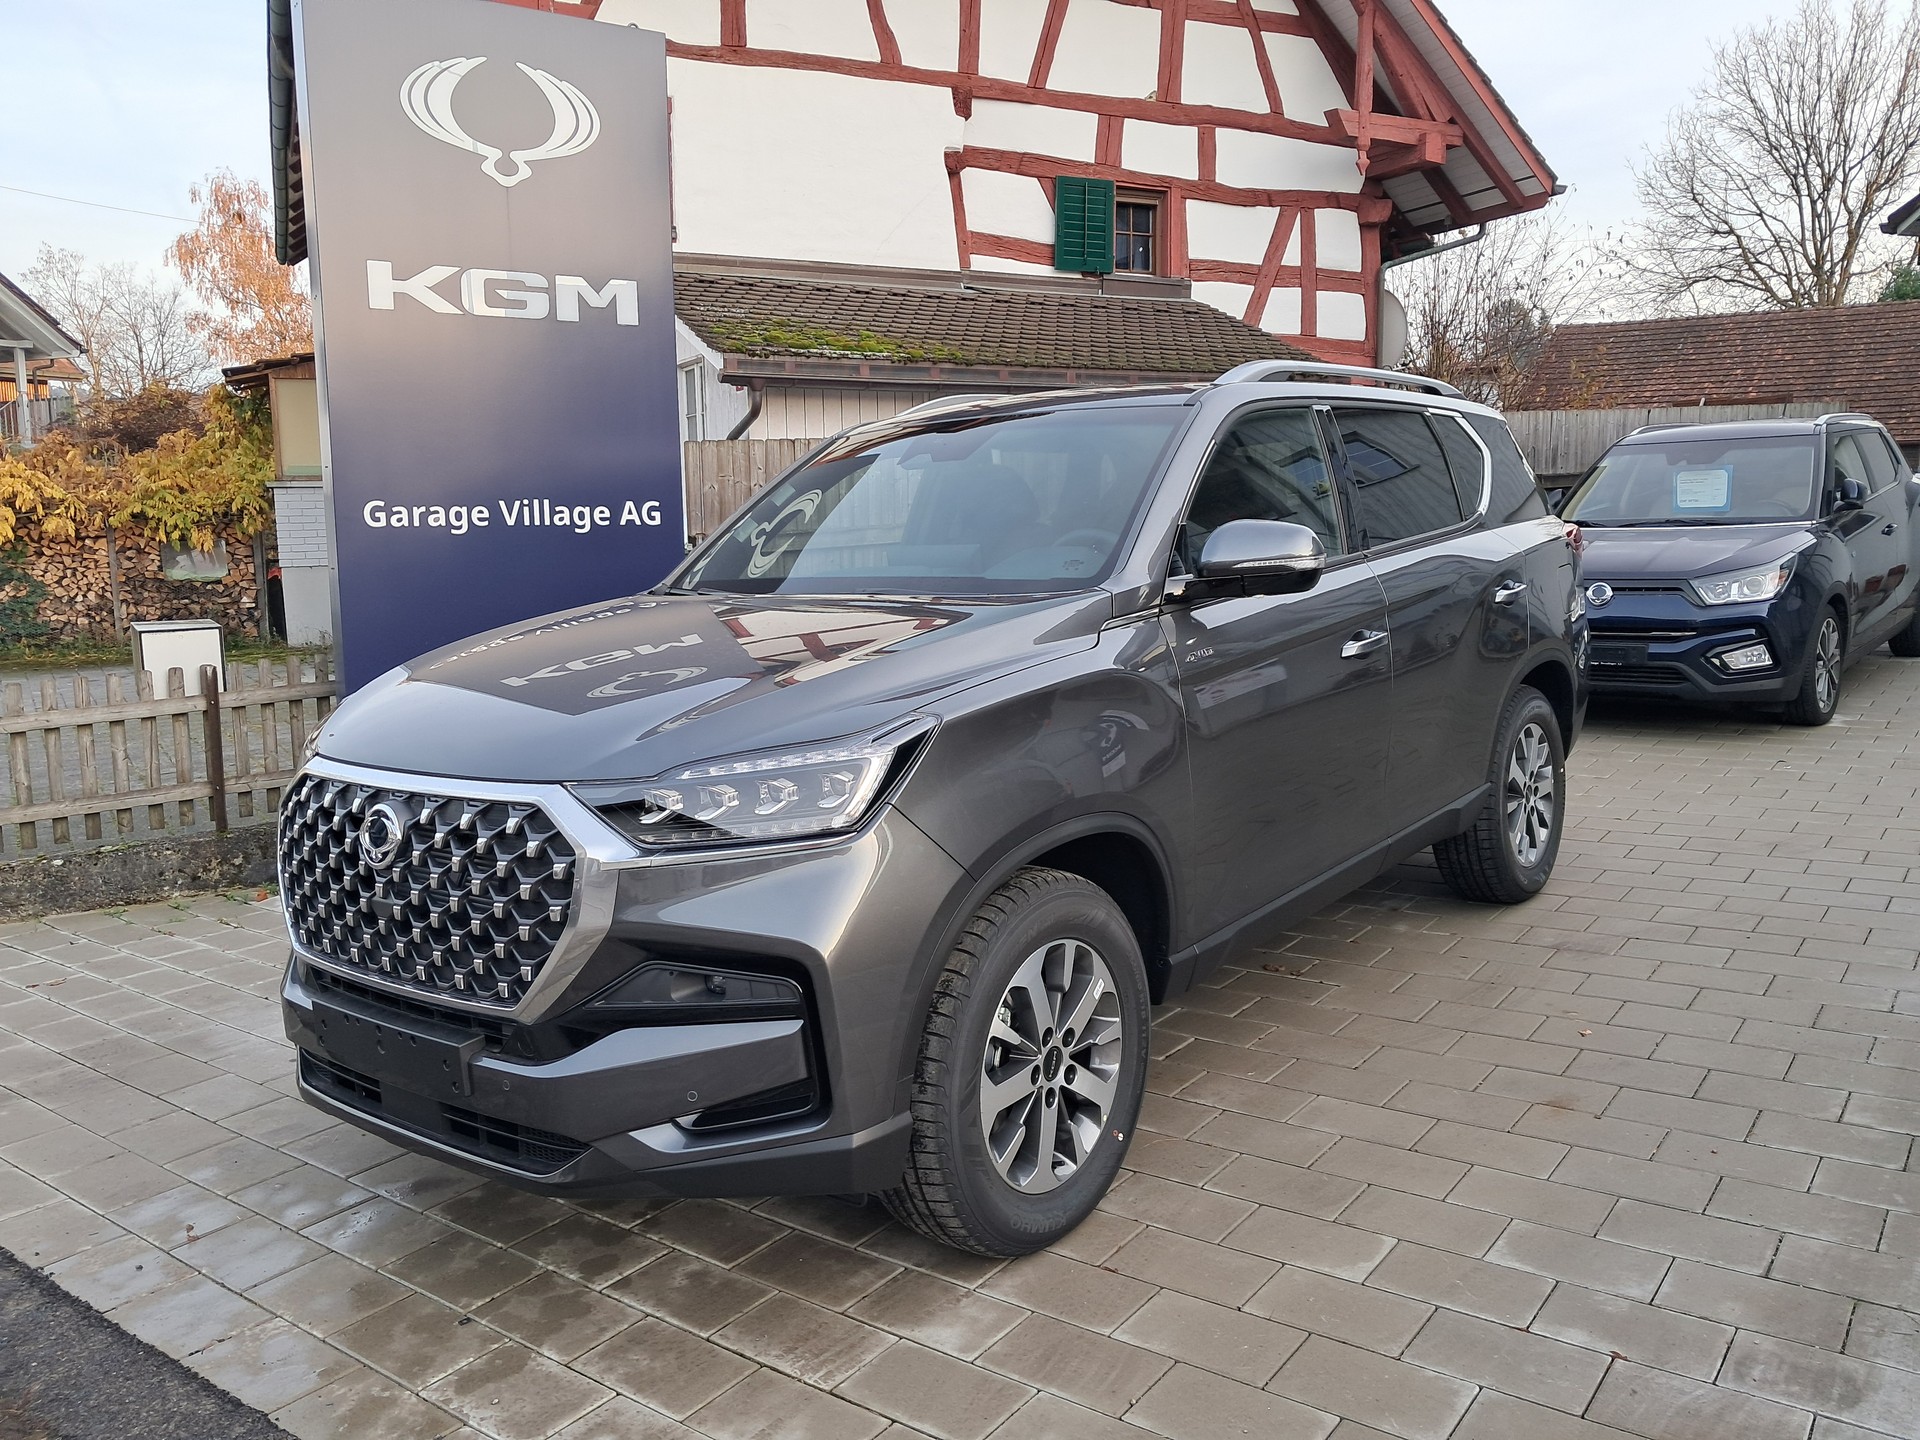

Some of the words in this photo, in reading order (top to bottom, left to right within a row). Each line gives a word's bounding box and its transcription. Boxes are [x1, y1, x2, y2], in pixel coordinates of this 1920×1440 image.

[366, 259, 639, 326] KGM
[363, 500, 490, 535] Garage
[498, 498, 611, 534] Village
[619, 501, 662, 526] AG
